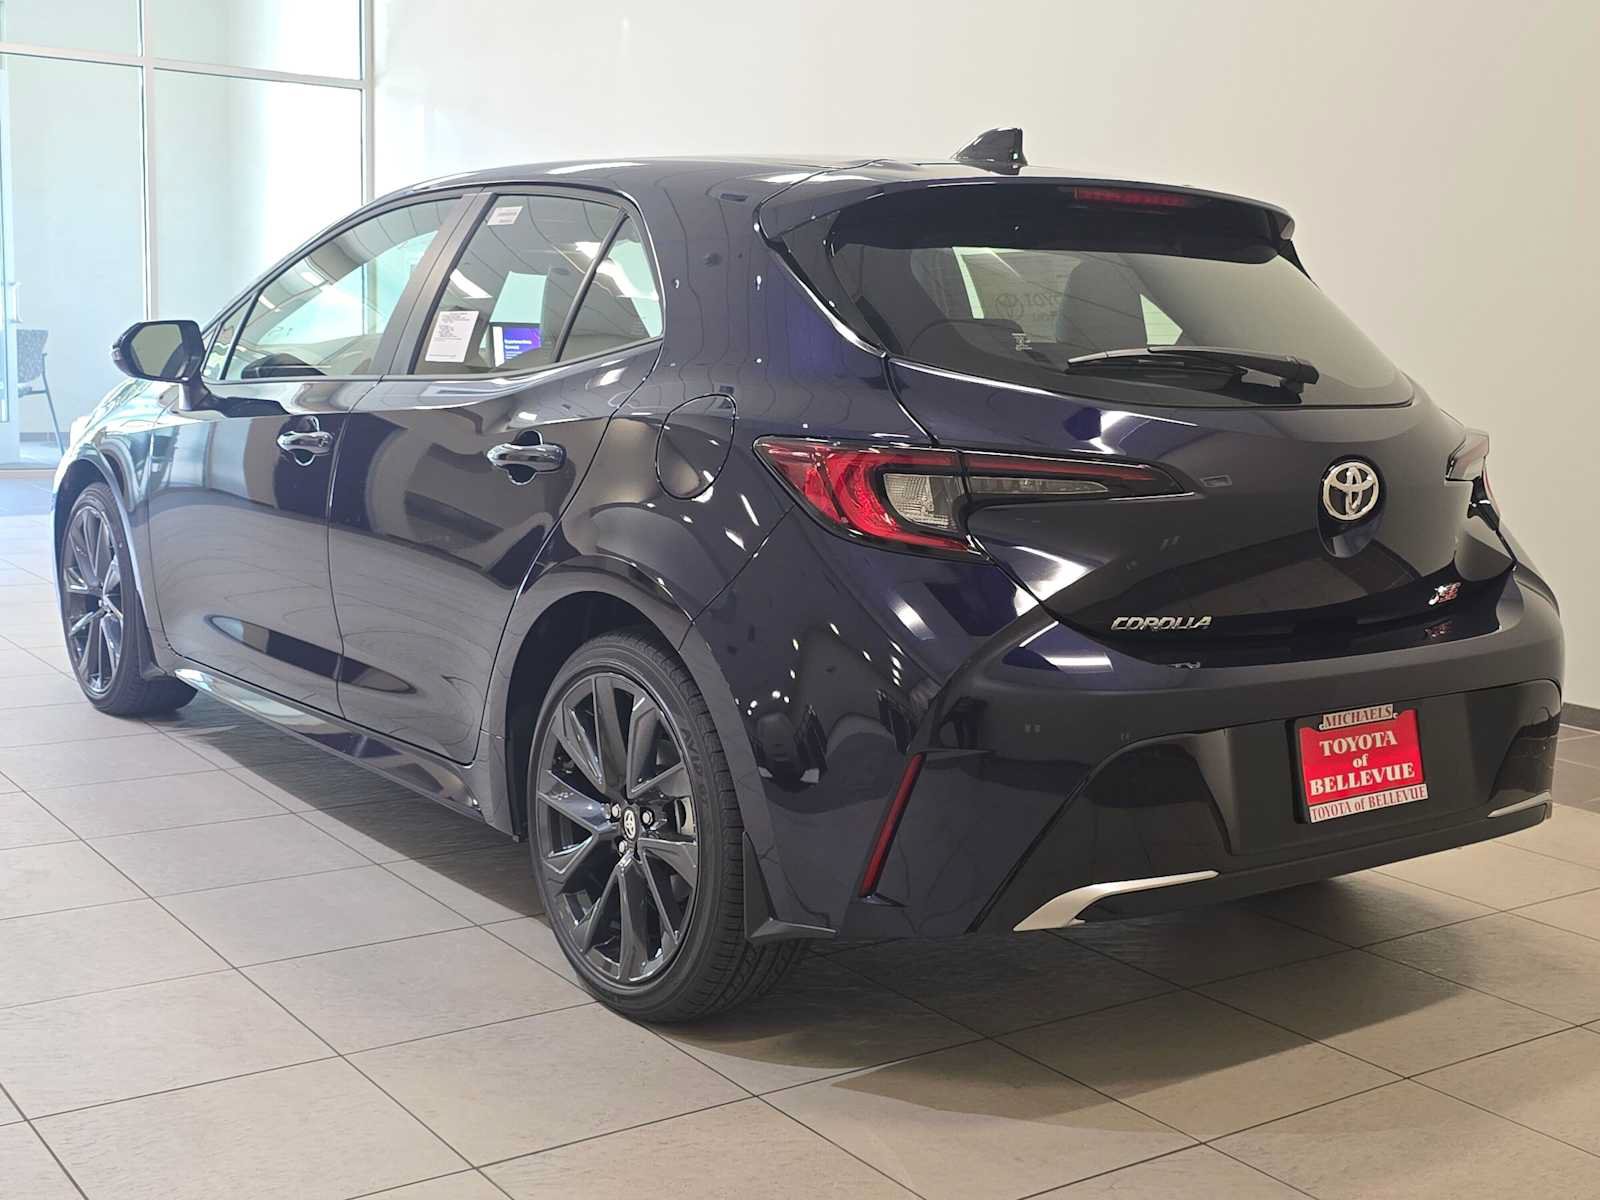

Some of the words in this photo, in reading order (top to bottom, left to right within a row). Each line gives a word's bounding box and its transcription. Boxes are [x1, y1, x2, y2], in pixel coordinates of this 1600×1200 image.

[1111, 616, 1212, 631] COROLLA
[1324, 705, 1392, 728] MICHAELS
[1319, 730, 1397, 756] TOYOTA
[1352, 753, 1368, 768] of
[1309, 762, 1415, 796] BELLEVUE
[1312, 800, 1353, 821] TOYOTA
[1354, 798, 1365, 811] of
[1368, 785, 1425, 809] BELLEVUE
